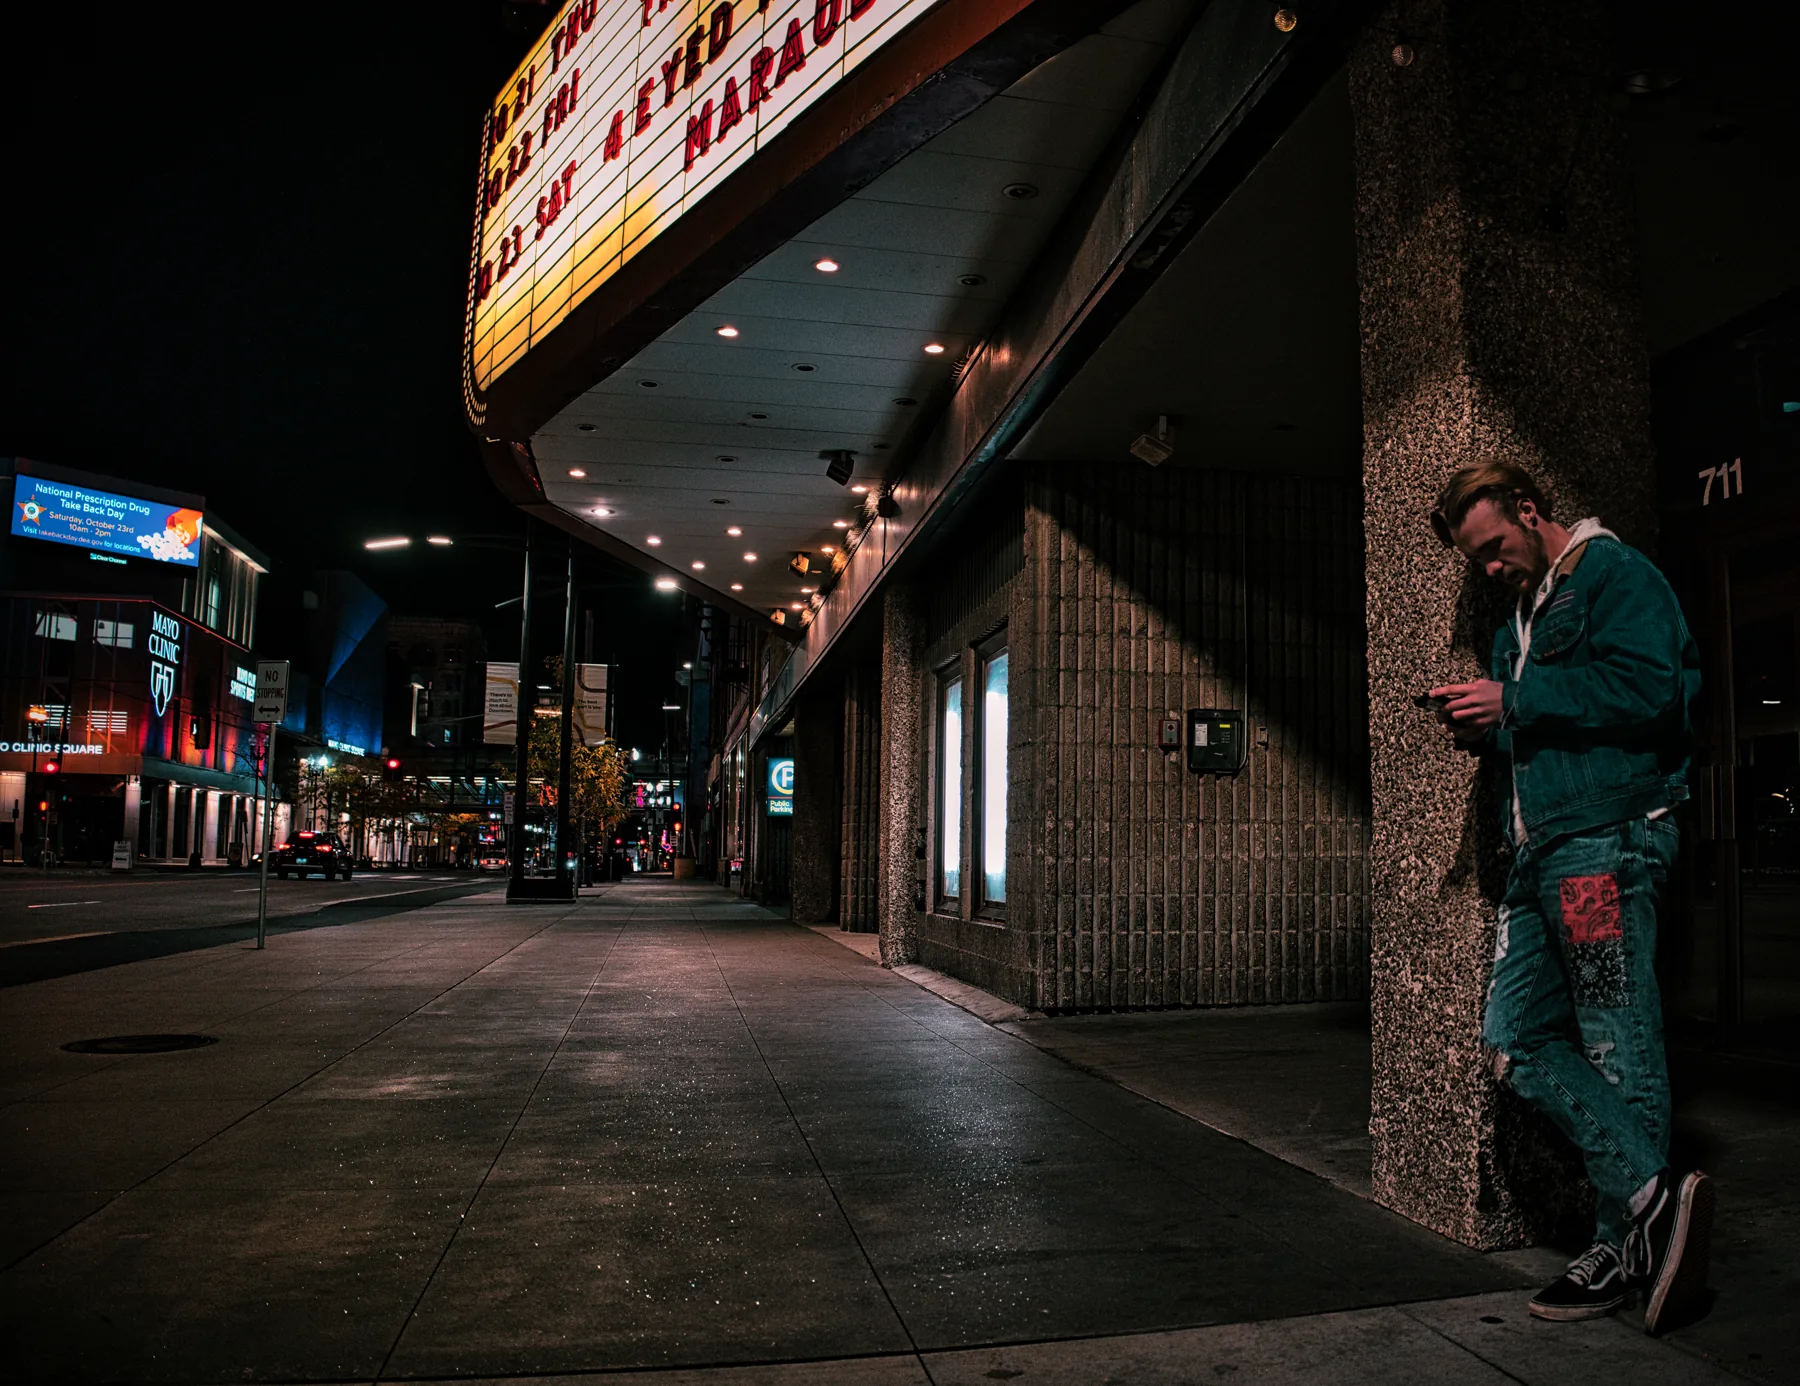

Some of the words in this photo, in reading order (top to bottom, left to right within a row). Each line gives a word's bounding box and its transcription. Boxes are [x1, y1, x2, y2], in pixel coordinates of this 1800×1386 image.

[513, 64, 536, 123] 21
[551, 0, 598, 75] THU
[497, 225, 523, 283] 23
[534, 159, 577, 242] SAT
[603, 109, 624, 165] 4
[634, 1, 734, 137] EYED
[505, 130, 533, 192] 22
[541, 68, 580, 149] FRI
[1698, 456, 1743, 506] 711
[35, 483, 73, 498] National
[75, 491, 128, 510] Prescription
[129, 502, 151, 516] Drug
[60, 498, 81, 510] Take
[83, 503, 105, 516] Back
[107, 508, 125, 520] Day
[22, 525, 38, 535] Visit
[103, 540, 113, 548] for
[113, 541, 141, 553] locations
[69, 523, 89, 534] 10am
[95, 528, 112, 538] 2pm
[85, 518, 115, 530] October
[117, 523, 135, 534] 23rd
[152, 610, 179, 640] MAYO
[148, 633, 180, 664] CLINIC
[265, 670, 279, 682] NO
[256, 687, 285, 699] STOPPING
[12, 742, 52, 754] CLINIC
[54, 743, 103, 755] SQUARE
[769, 799, 790, 807] Public
